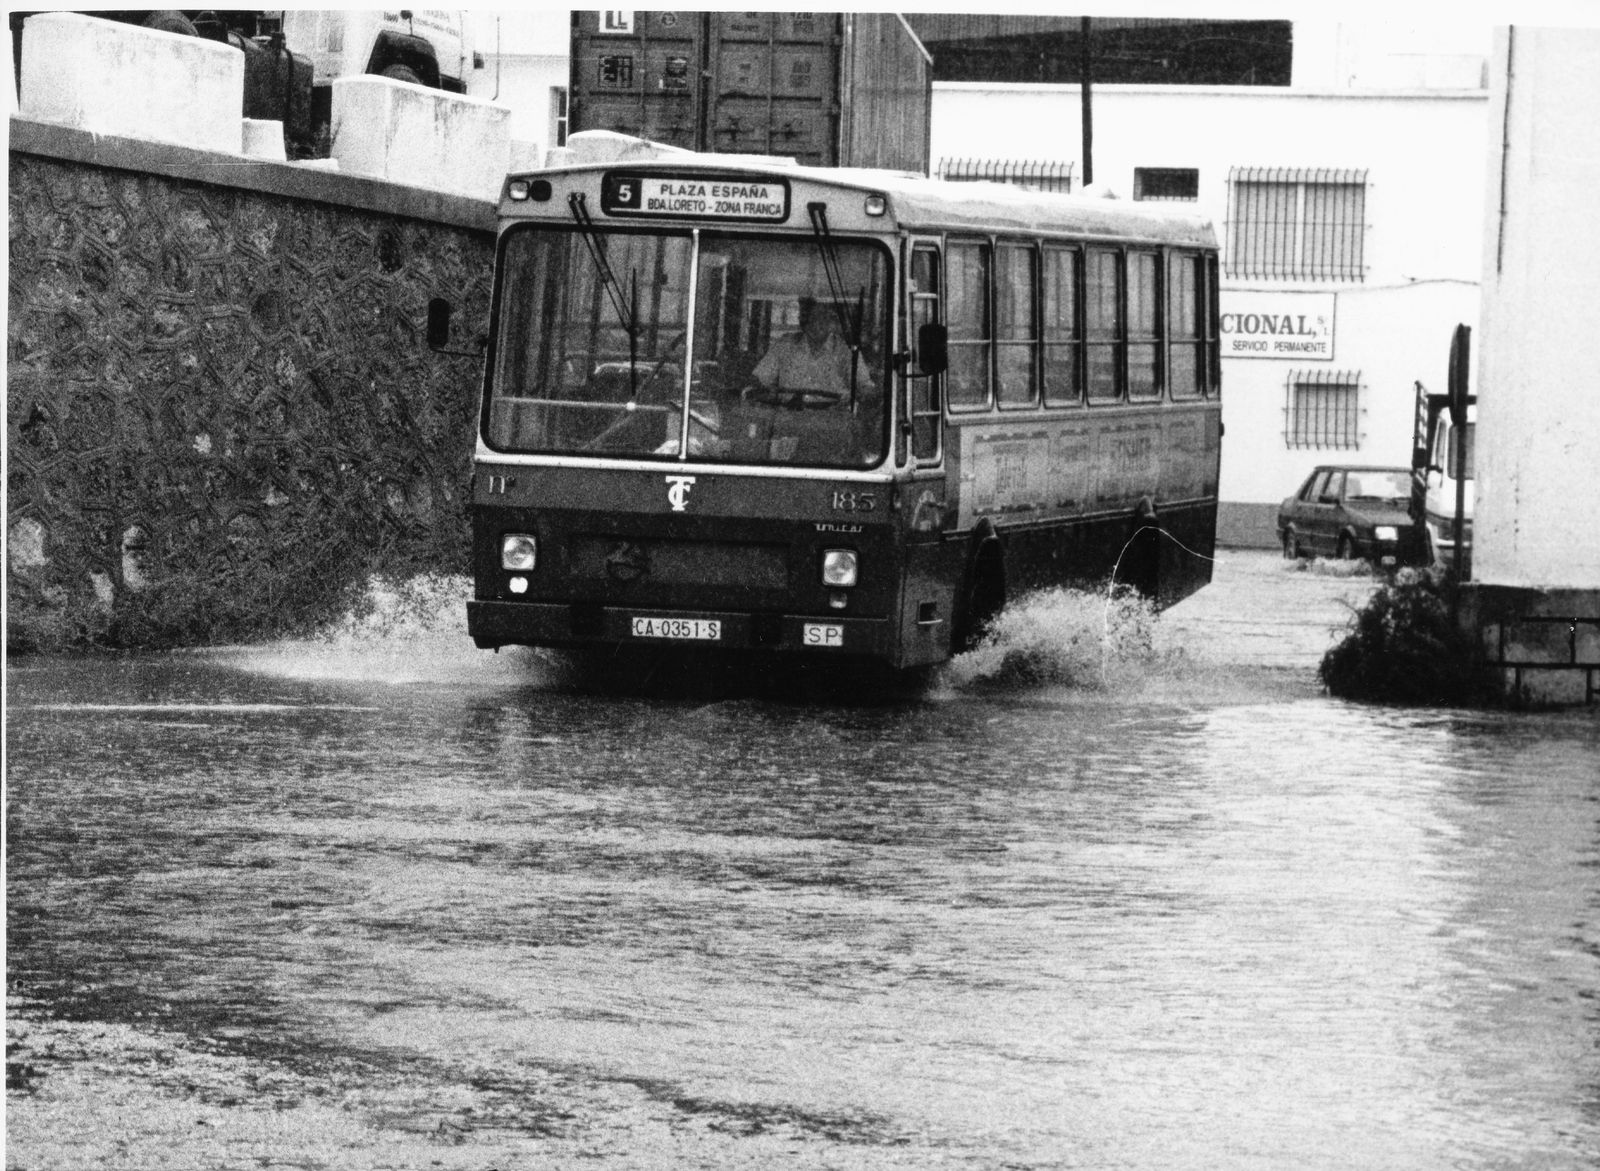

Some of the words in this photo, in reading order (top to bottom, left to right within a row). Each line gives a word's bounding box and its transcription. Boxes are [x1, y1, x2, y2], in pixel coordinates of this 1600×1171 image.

[618, 184, 632, 202] 5
[660, 183, 706, 197] PLAZA
[711, 184, 769, 199] ESPAÑA
[714, 201, 741, 214] ZONA
[743, 203, 782, 216] FRANCA
[1232, 340, 1268, 352] SERVICIO
[1274, 341, 1327, 353] PERMANENTE
[832, 490, 876, 513] 185
[808, 626, 839, 643] SP
